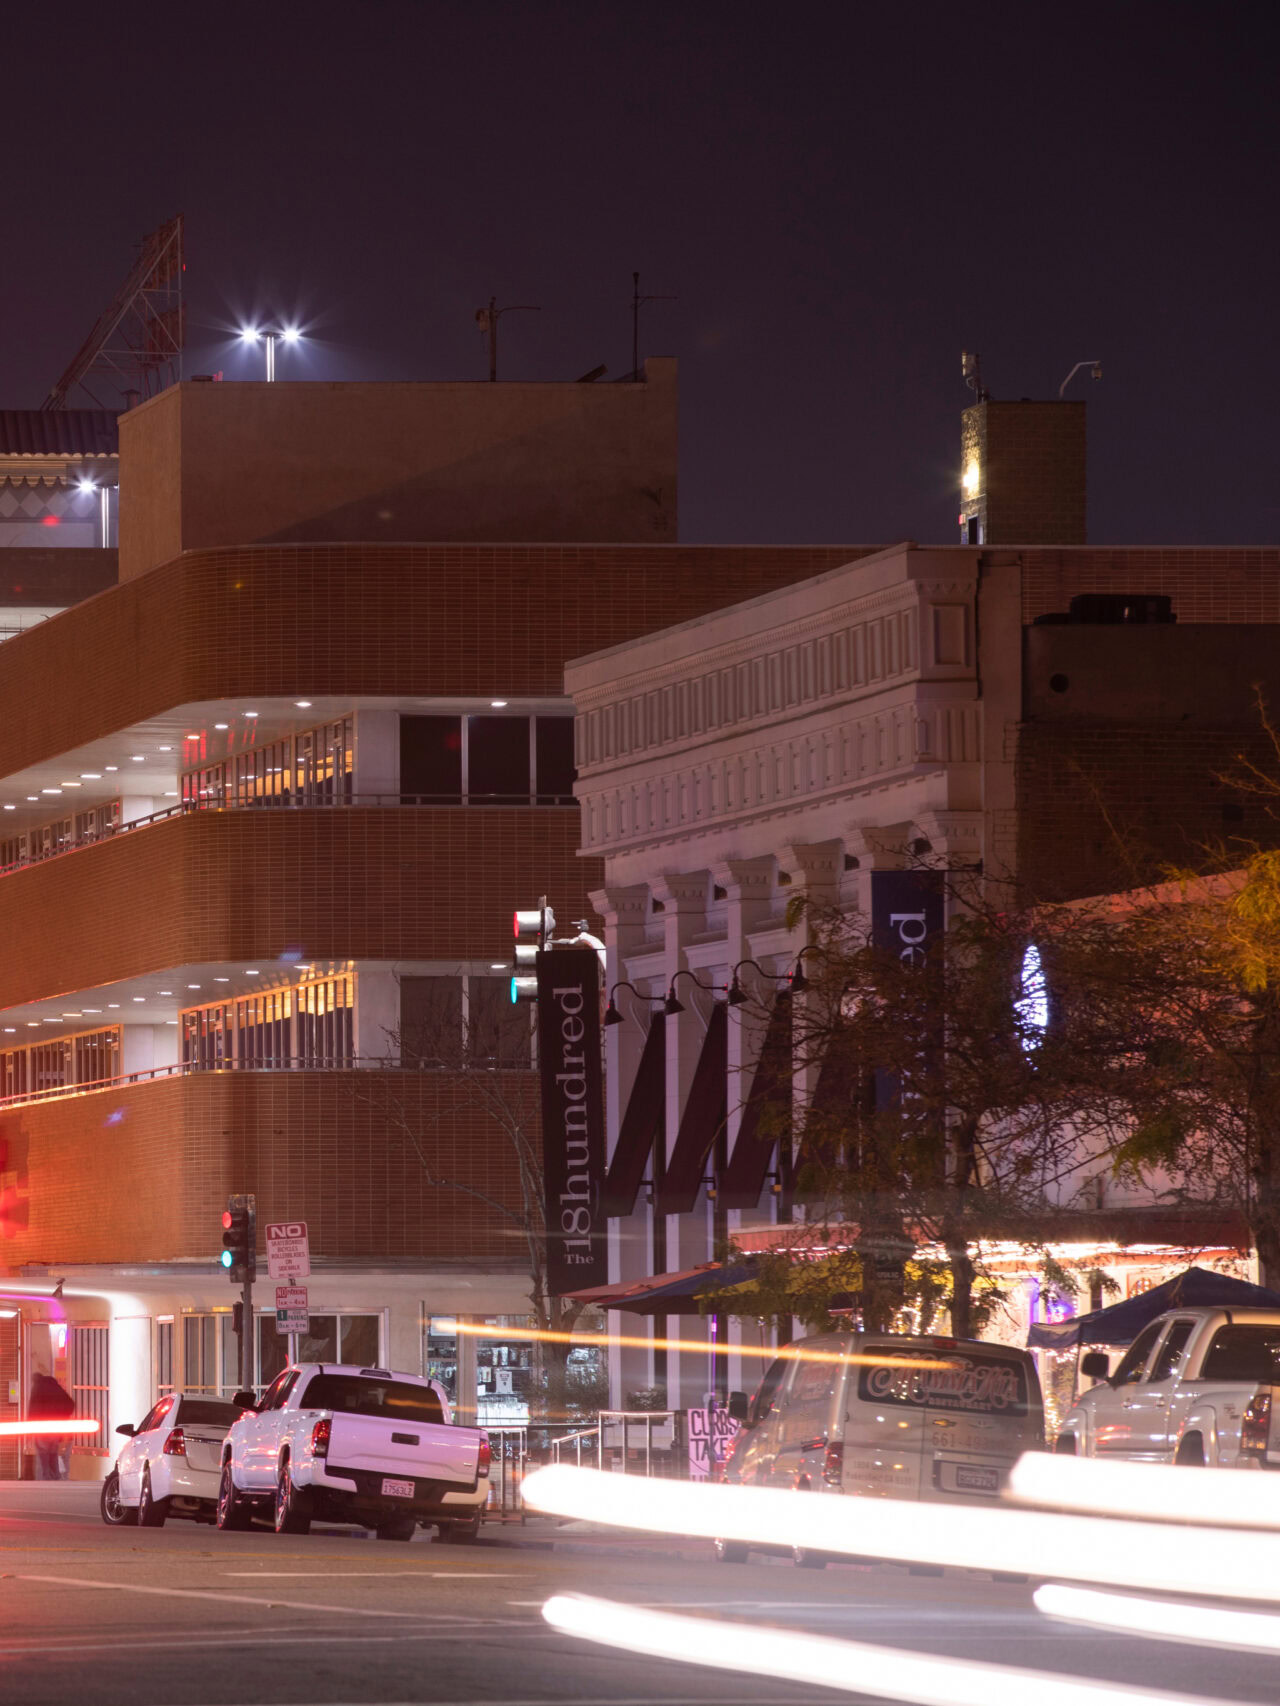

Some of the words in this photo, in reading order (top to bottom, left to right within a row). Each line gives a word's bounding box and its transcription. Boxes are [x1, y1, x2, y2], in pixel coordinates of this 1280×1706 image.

[553, 983, 592, 1251] 18hundred
[271, 1225, 302, 1238] NO
[564, 1254, 595, 1265] The
